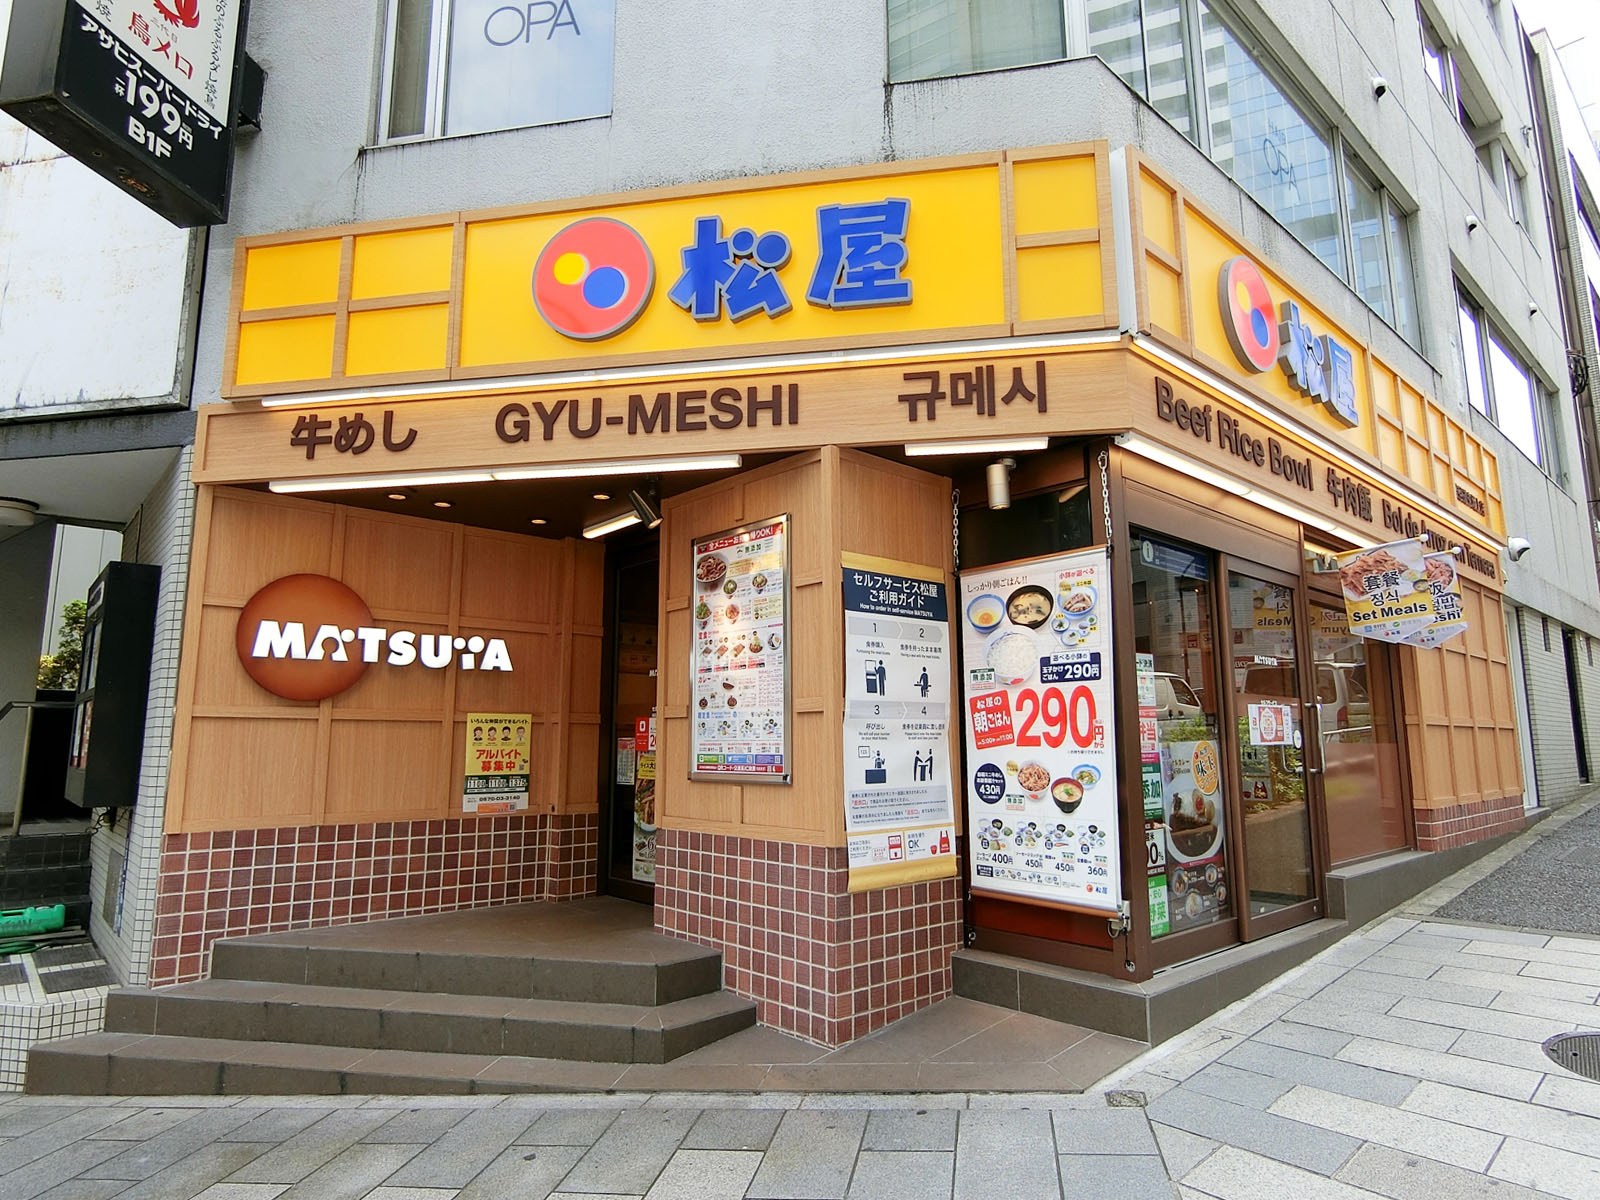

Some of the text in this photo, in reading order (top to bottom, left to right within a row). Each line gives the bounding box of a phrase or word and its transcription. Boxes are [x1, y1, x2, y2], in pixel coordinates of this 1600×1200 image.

[485, 0, 581, 46] OPA
[128, 12, 193, 80] 鳥メロ
[81, 13, 222, 140] アサヒスーパードライ
[128, 116, 172, 158] B1F
[1264, 138, 1300, 200] OPA
[668, 197, 913, 323] 松屋
[1278, 299, 1360, 429] 松屋
[897, 360, 1047, 422] 규메시
[495, 384, 798, 444] GYU-MESHI
[1155, 376, 1314, 492] Beef Rice Bowl
[290, 410, 418, 459] 牛めし
[1327, 467, 1373, 523] 牛肉飯
[1382, 499, 1403, 534] Bol
[1405, 512, 1419, 539] de
[853, 573, 938, 597] セルフサービス松屋
[869, 590, 924, 608] ご利用ガイド
[1363, 570, 1400, 592] 套餐
[1370, 590, 1400, 607] 정식
[873, 623, 877, 632] 1
[1353, 602, 1428, 623] Set Meals
[252, 619, 514, 671] MATSUYA
[919, 628, 925, 638] 2
[874, 704, 880, 715] 3
[921, 706, 927, 716] 4
[973, 711, 1011, 733] 朝ごはん
[476, 749, 521, 760] アルバイト
[481, 760, 515, 772] 募集中
[908, 840, 919, 849] OK
